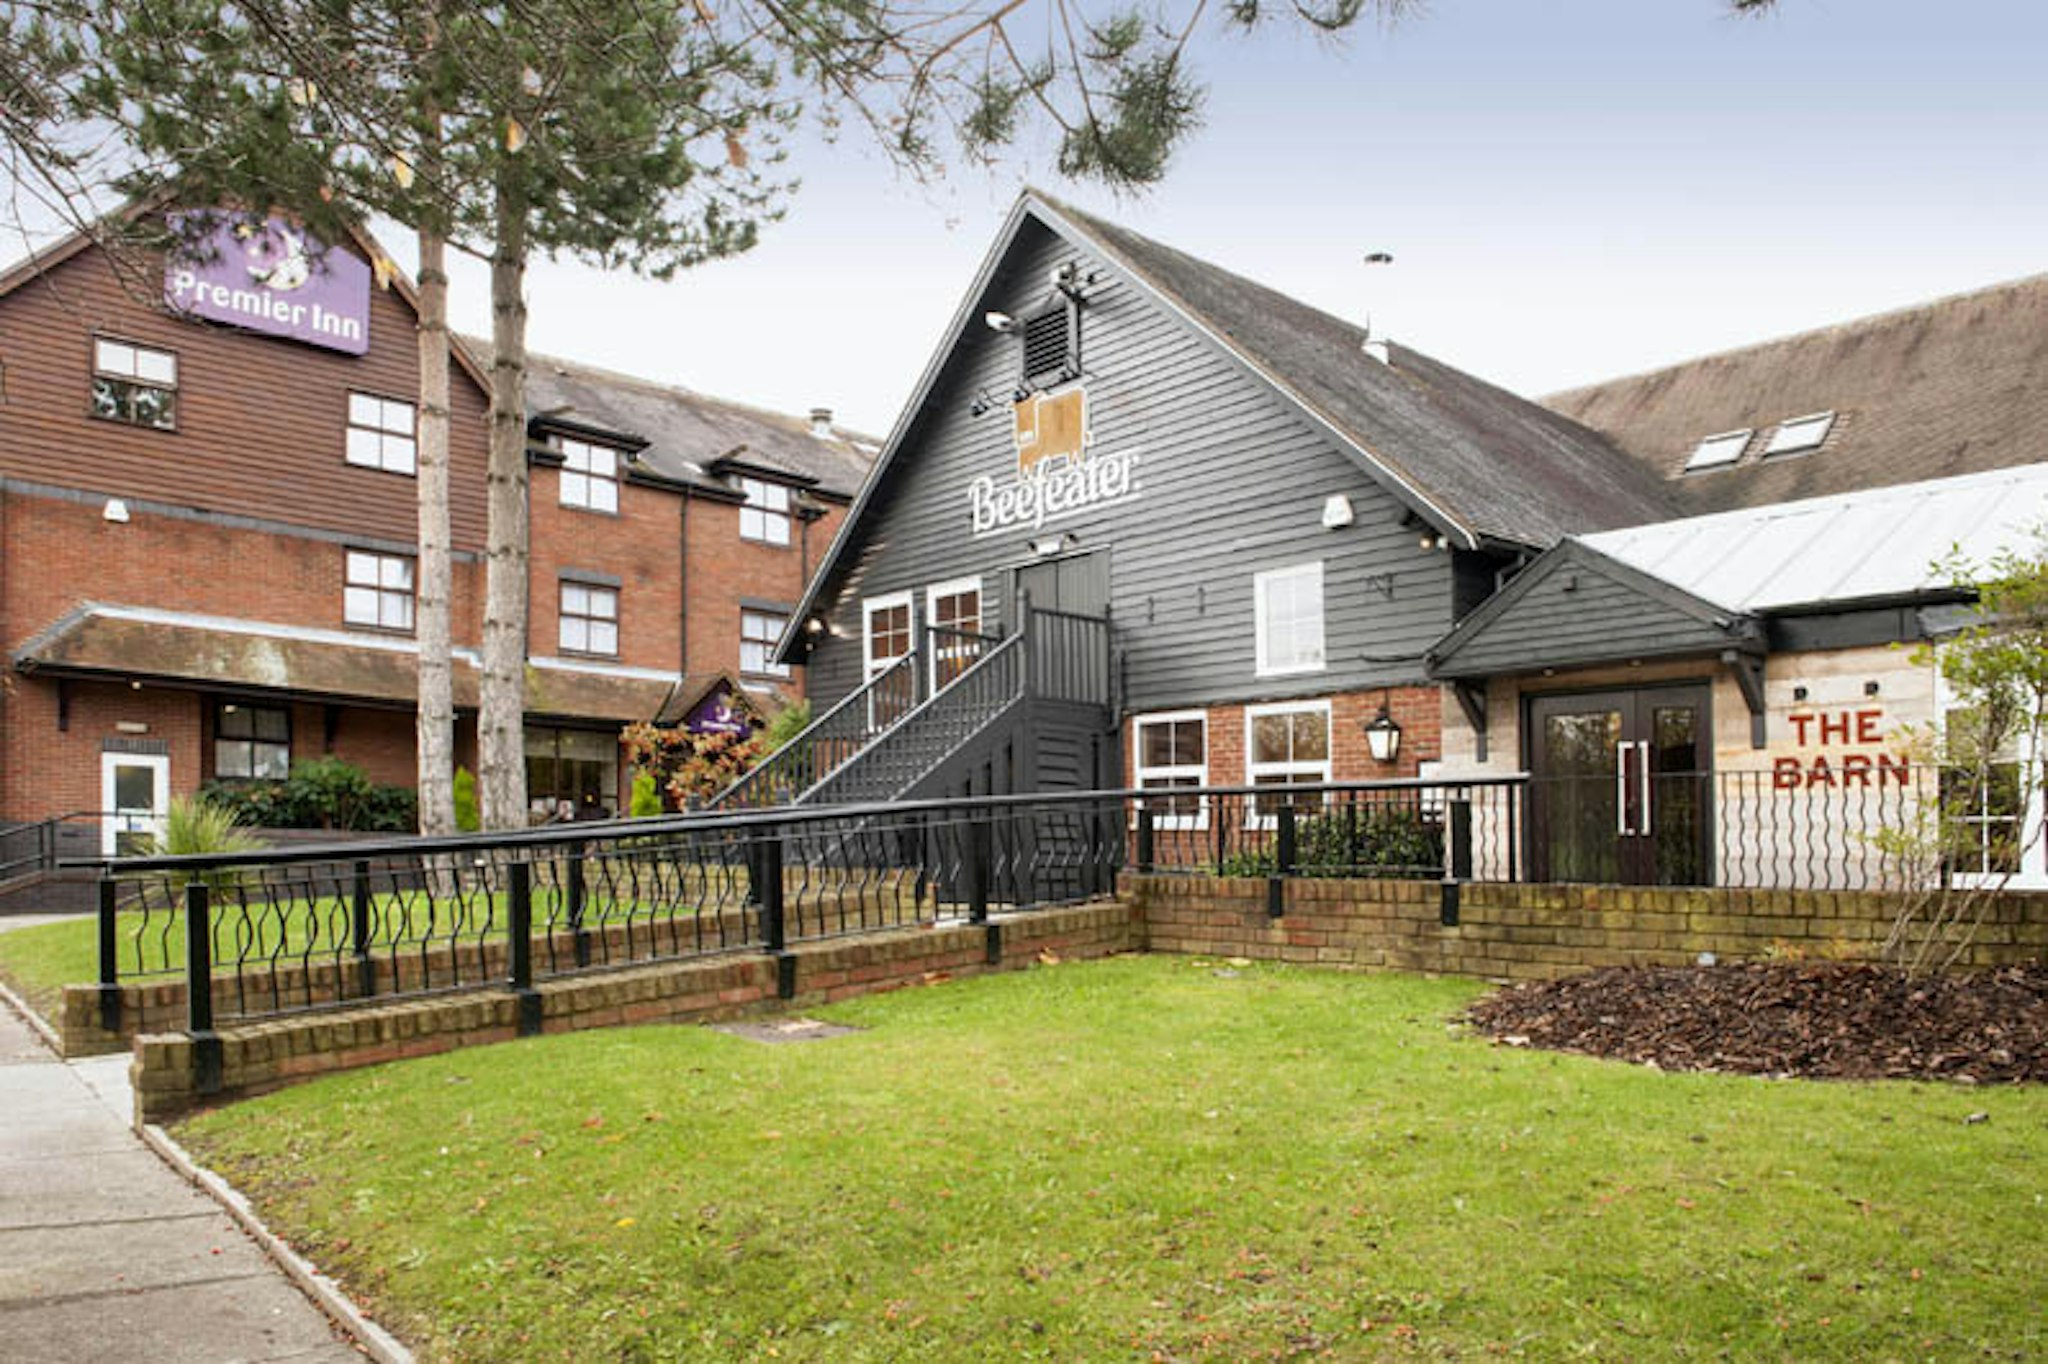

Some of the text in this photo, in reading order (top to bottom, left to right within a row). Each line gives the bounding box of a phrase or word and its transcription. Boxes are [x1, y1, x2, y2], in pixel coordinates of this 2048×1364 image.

[173, 268, 360, 340] Premier Inn
[968, 454, 1140, 531] Beefeater
[1788, 710, 1883, 747] THE
[1773, 753, 1910, 789] BARN
